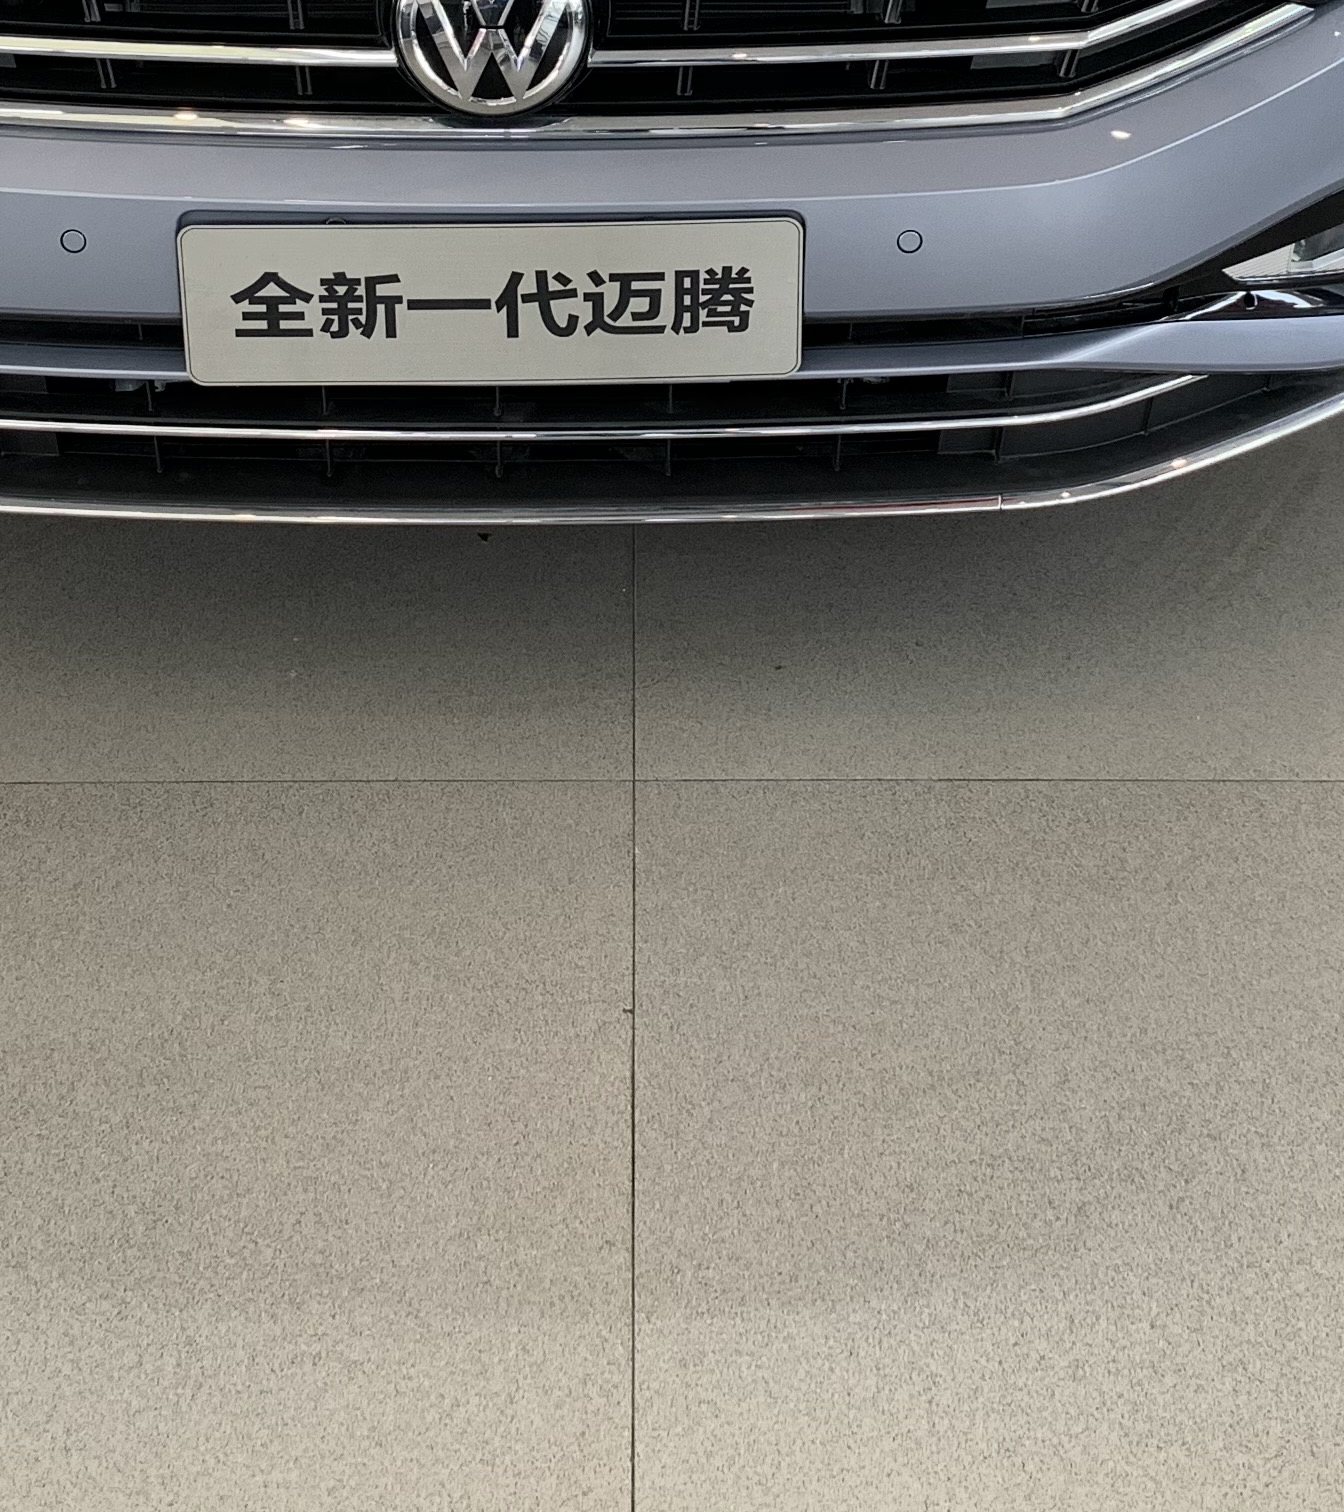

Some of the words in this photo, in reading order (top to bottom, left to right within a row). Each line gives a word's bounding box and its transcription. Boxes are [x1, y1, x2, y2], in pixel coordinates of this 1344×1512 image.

[229, 264, 757, 339] 全新一代迈腾
